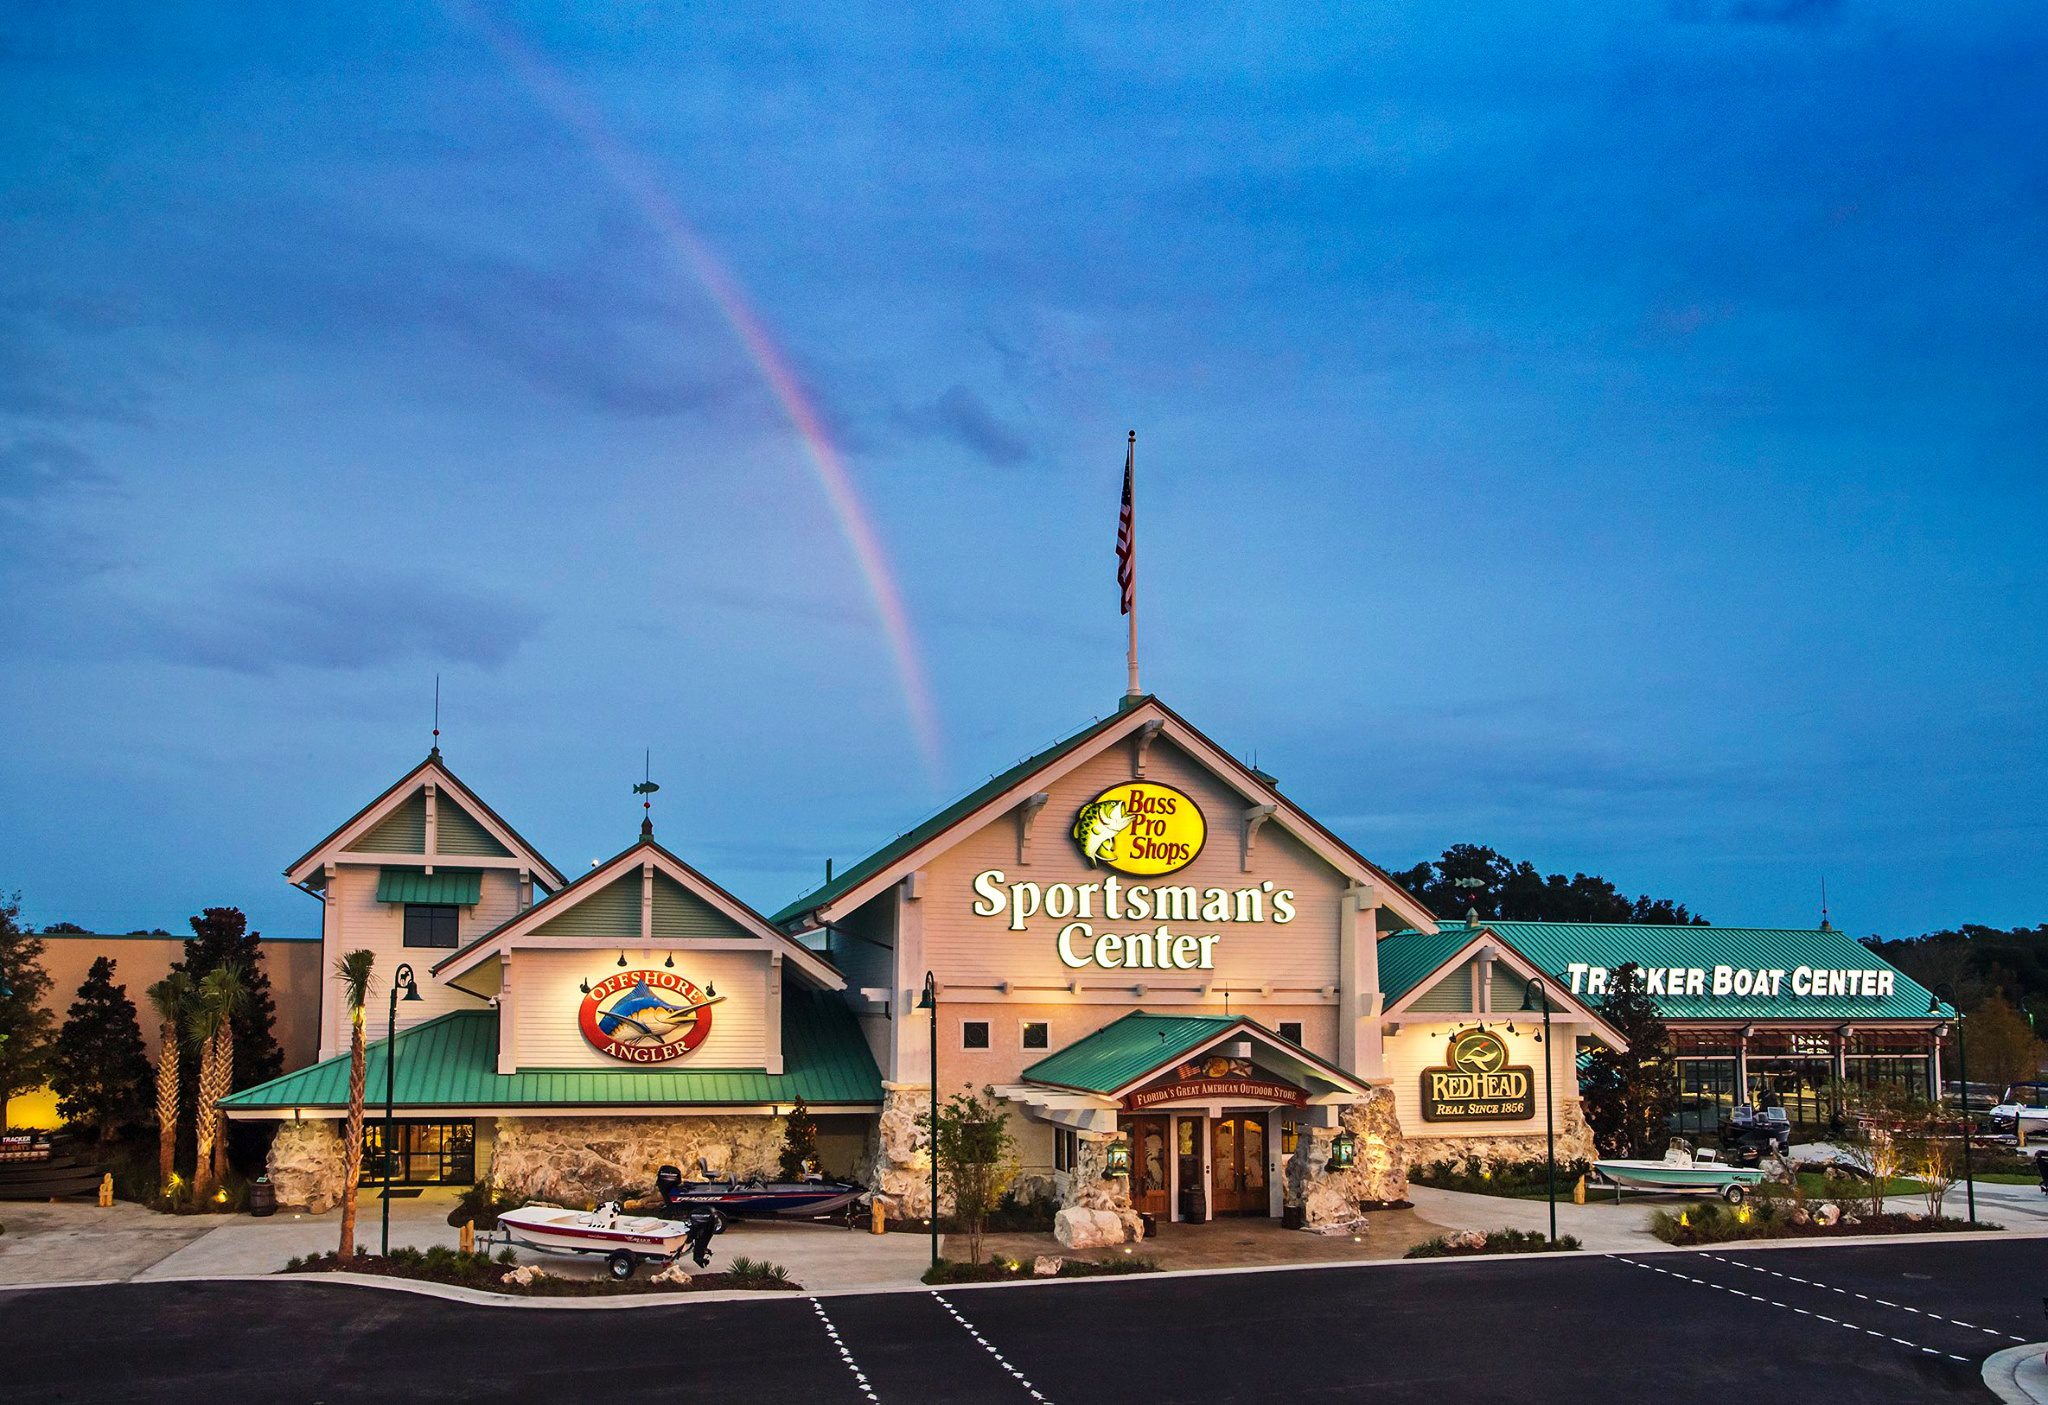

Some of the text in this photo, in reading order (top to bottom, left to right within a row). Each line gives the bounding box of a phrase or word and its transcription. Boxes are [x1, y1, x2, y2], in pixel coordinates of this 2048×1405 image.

[1127, 789, 1177, 815] Bass
[1130, 813, 1167, 837] Pro
[1129, 836, 1190, 865] Shops
[973, 869, 1297, 931] Sportsman's
[1057, 922, 1221, 969] Center
[590, 971, 702, 1004] OFFSHORE
[1713, 965, 1785, 996] BOAT
[1791, 965, 1895, 996] CENTER
[602, 1040, 691, 1062] ANGLER
[1137, 1083, 1296, 1105] FLORIDA'S GREAT AMERICAN OUTDOOR STORE
[1431, 1072, 1528, 1101] REDHEAD
[1436, 1103, 1525, 1115] REAL SINCE 1856
